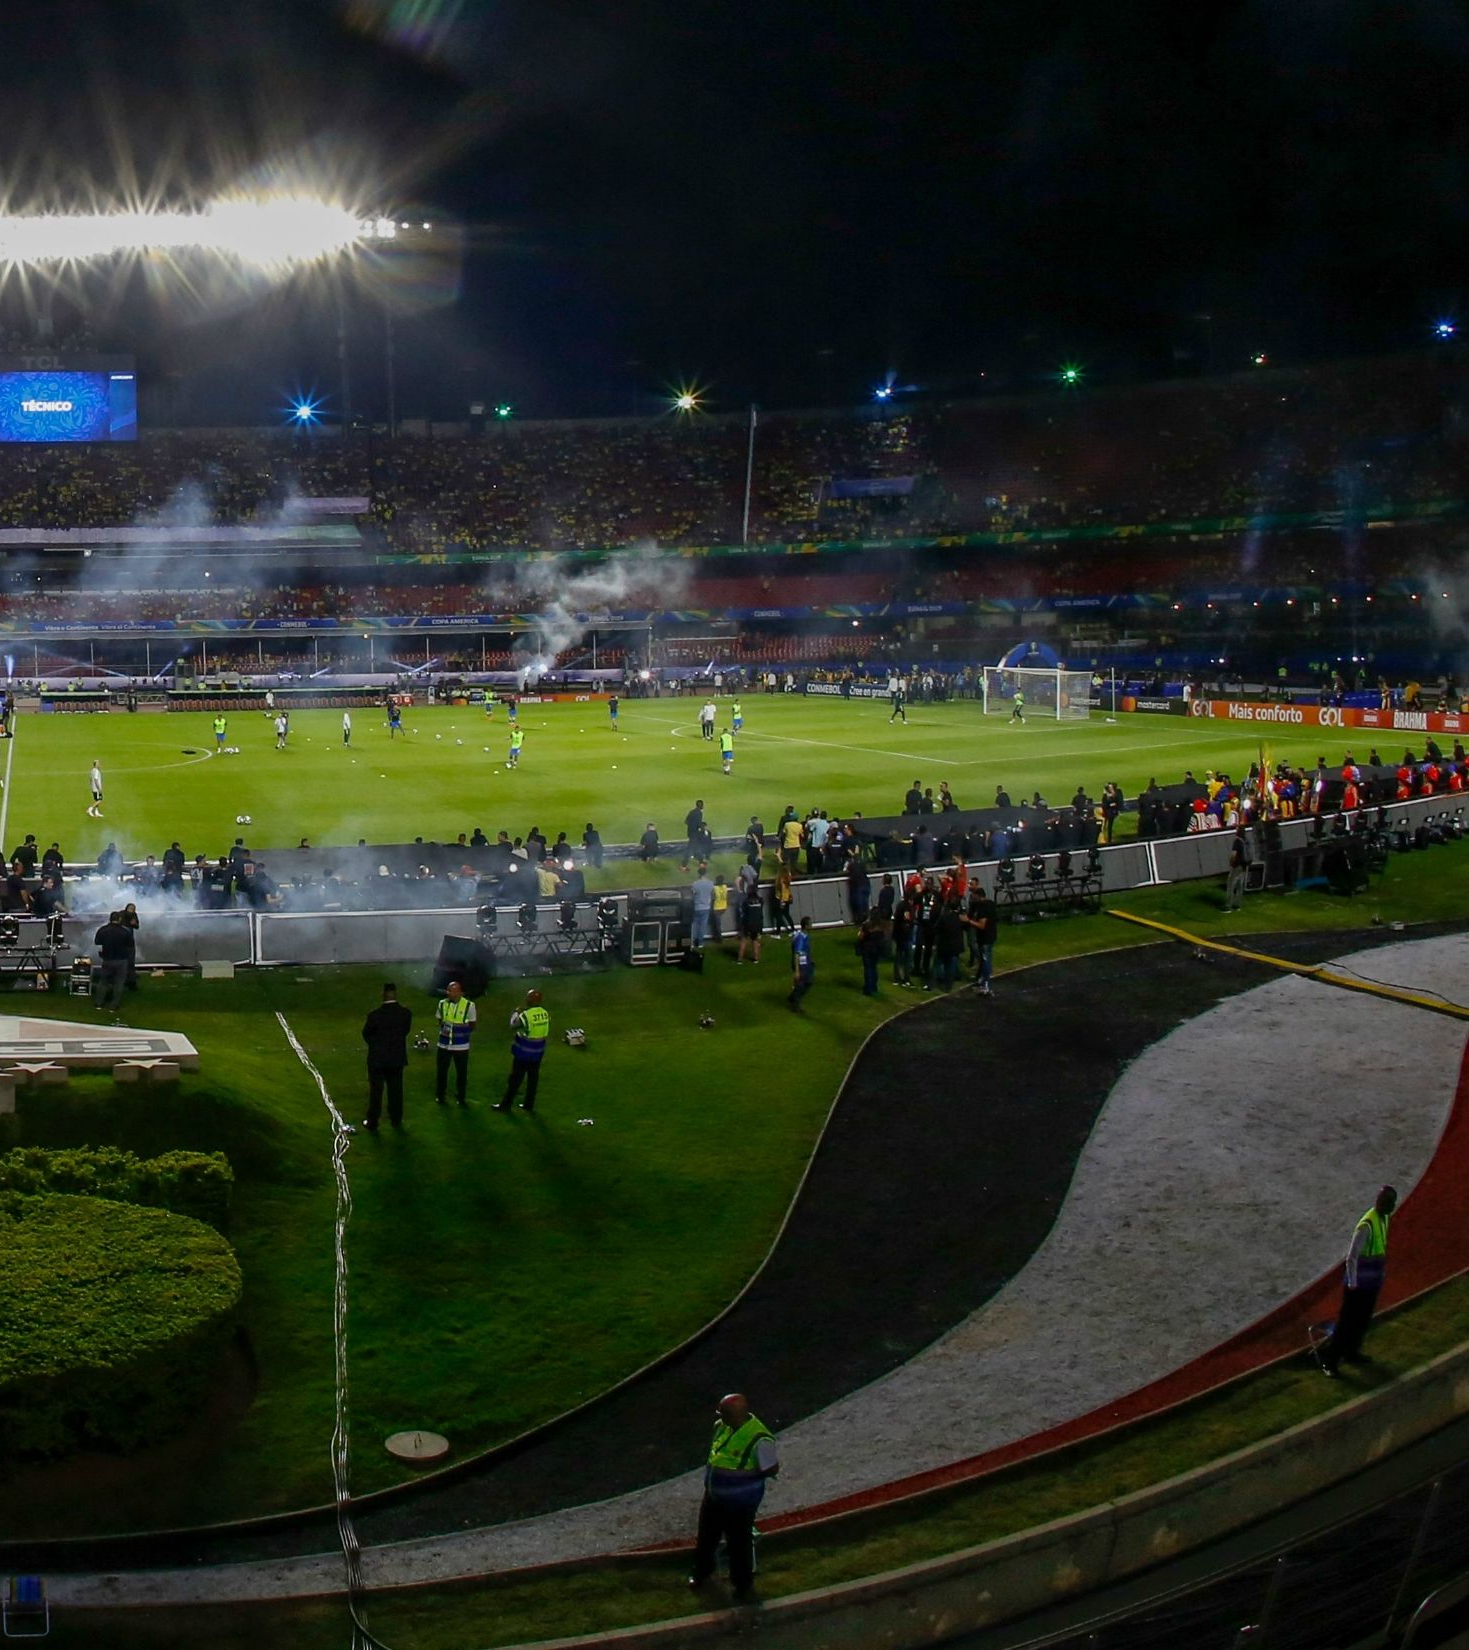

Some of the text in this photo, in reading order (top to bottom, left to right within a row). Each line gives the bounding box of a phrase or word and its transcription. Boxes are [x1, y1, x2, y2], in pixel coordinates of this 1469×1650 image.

[20, 356, 65, 369] TCL
[21, 401, 72, 412] TÉCNICO
[807, 683, 842, 695] CONMEBOL
[863, 688, 870, 696] en
[1137, 701, 1170, 710] mastercard
[1192, 700, 1215, 718] GOL
[1228, 703, 1303, 723] Mais conforto
[1318, 707, 1345, 727] GOL
[1393, 711, 1428, 730] BRAHMA
